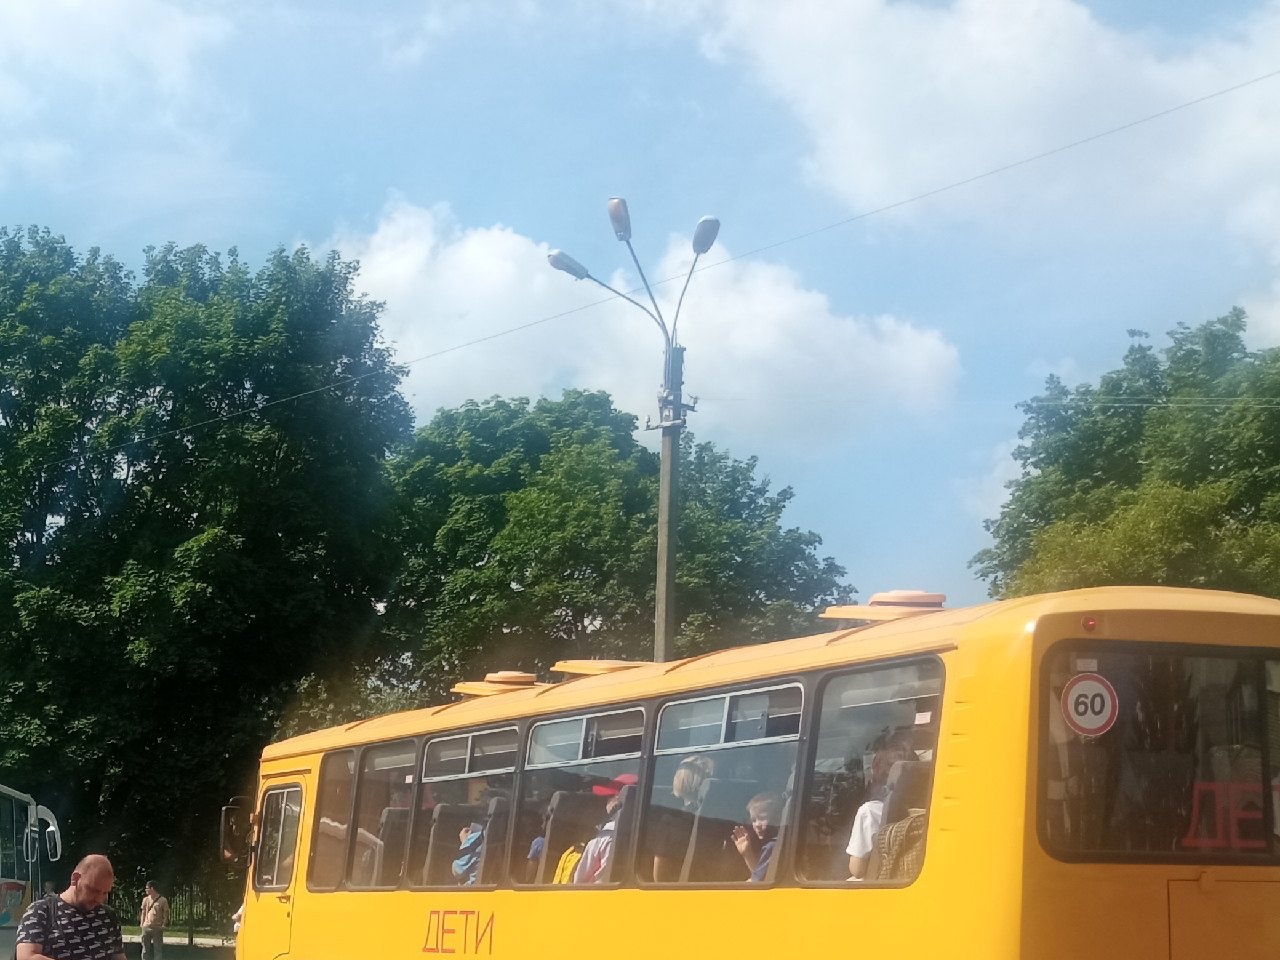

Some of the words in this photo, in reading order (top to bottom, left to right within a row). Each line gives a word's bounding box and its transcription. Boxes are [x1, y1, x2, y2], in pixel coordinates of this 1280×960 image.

[1073, 692, 1106, 717] 60
[1181, 782, 1280, 848] ДЕ
[422, 910, 495, 955] ДЕТИ
